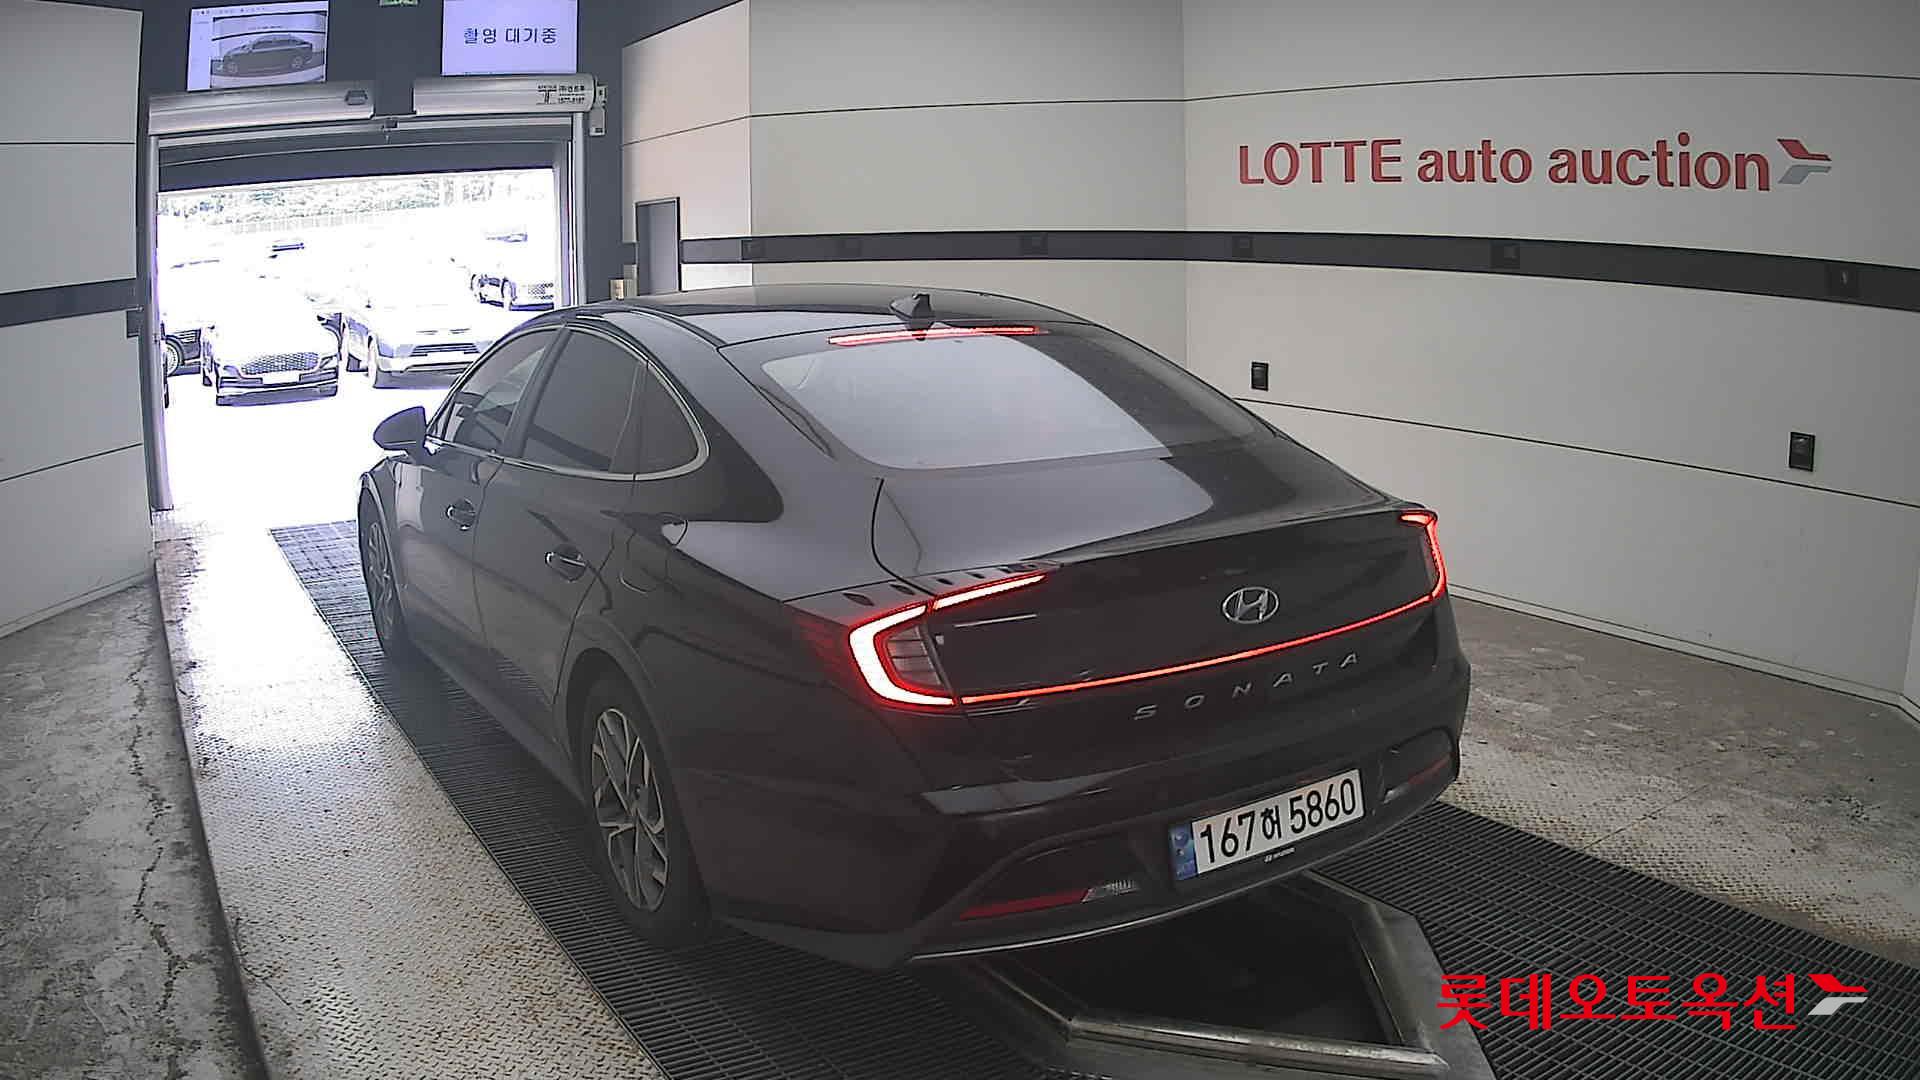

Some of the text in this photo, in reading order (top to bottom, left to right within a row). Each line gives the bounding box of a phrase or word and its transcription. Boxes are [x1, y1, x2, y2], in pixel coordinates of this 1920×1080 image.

[505, 27, 558, 44] 대기중
[1239, 132, 1771, 192] LOTTE auto auction
[1133, 652, 1359, 720] SONATA
[1200, 777, 1357, 864] 167허 5860
